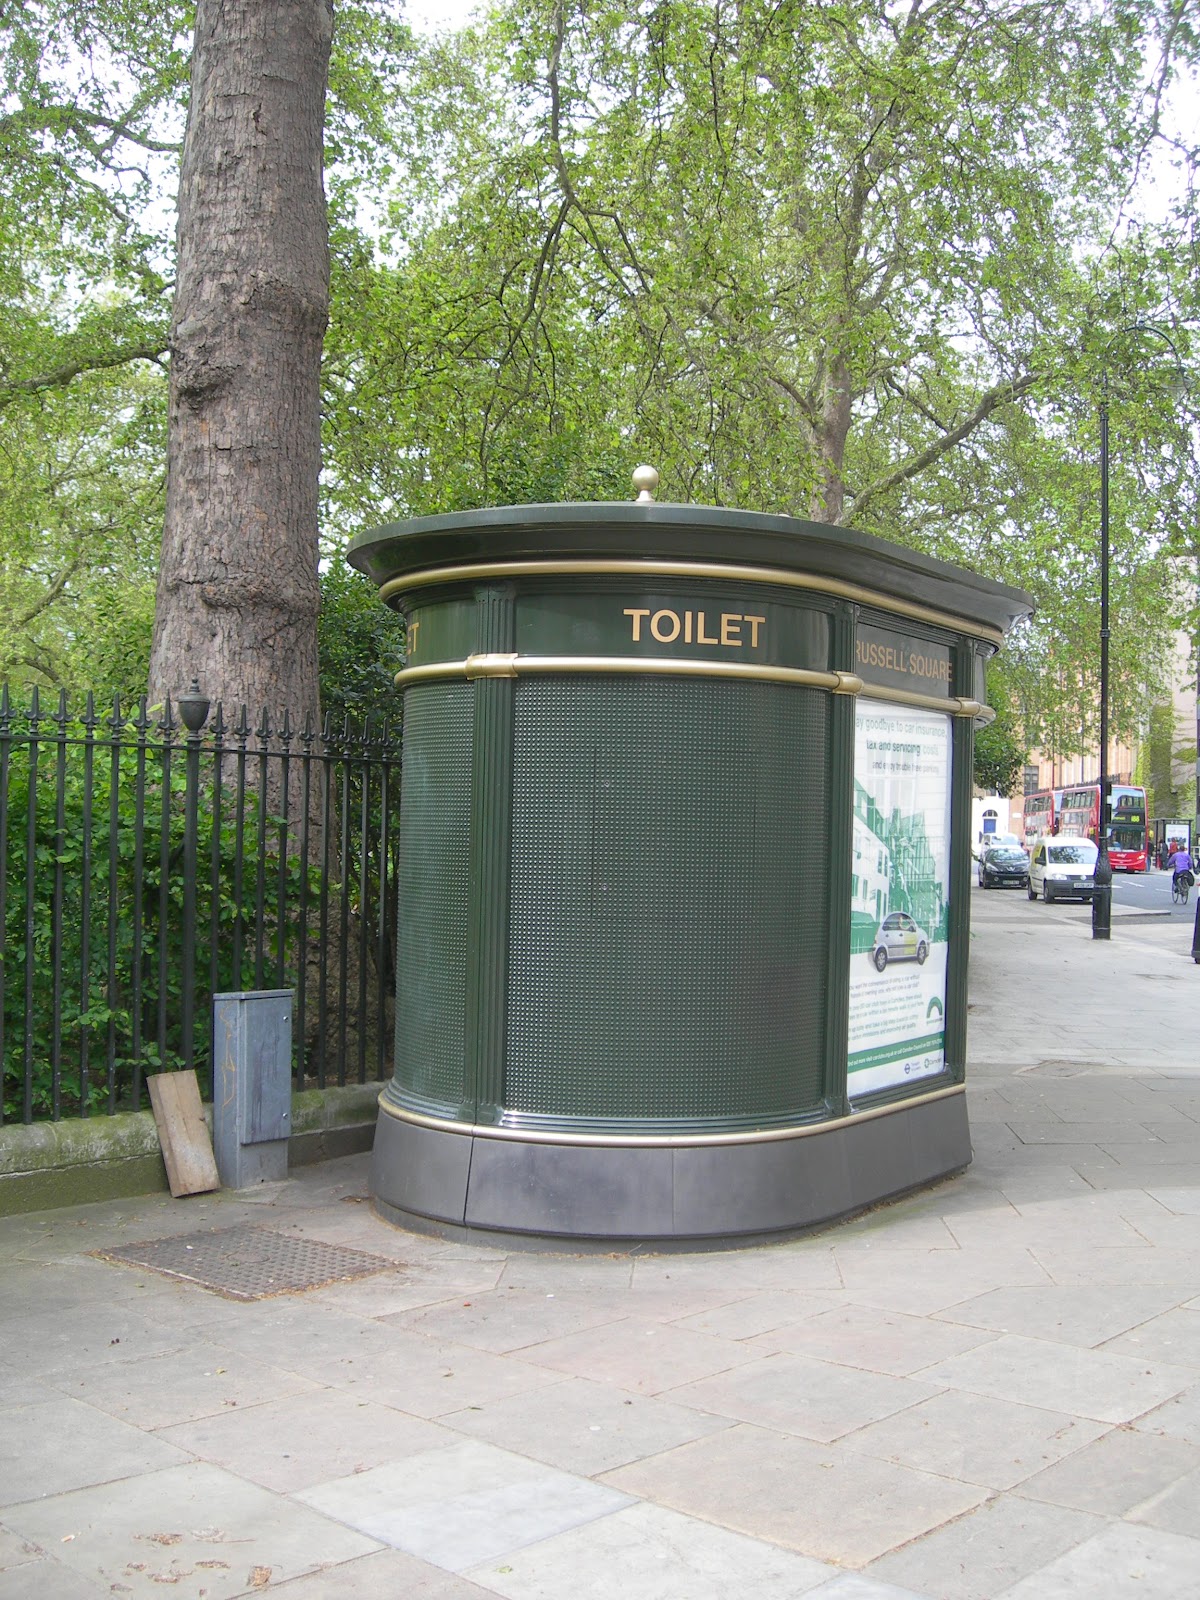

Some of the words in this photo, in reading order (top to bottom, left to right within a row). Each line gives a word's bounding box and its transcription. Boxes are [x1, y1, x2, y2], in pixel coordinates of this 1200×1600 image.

[623, 608, 766, 648] TOILET
[909, 653, 952, 682] SQUARE
[866, 718, 895, 733] goodbye
[897, 720, 903, 732] to
[905, 722, 914, 734] car
[866, 739, 877, 750] tax
[878, 740, 891, 751] and
[892, 742, 921, 756] servicing
